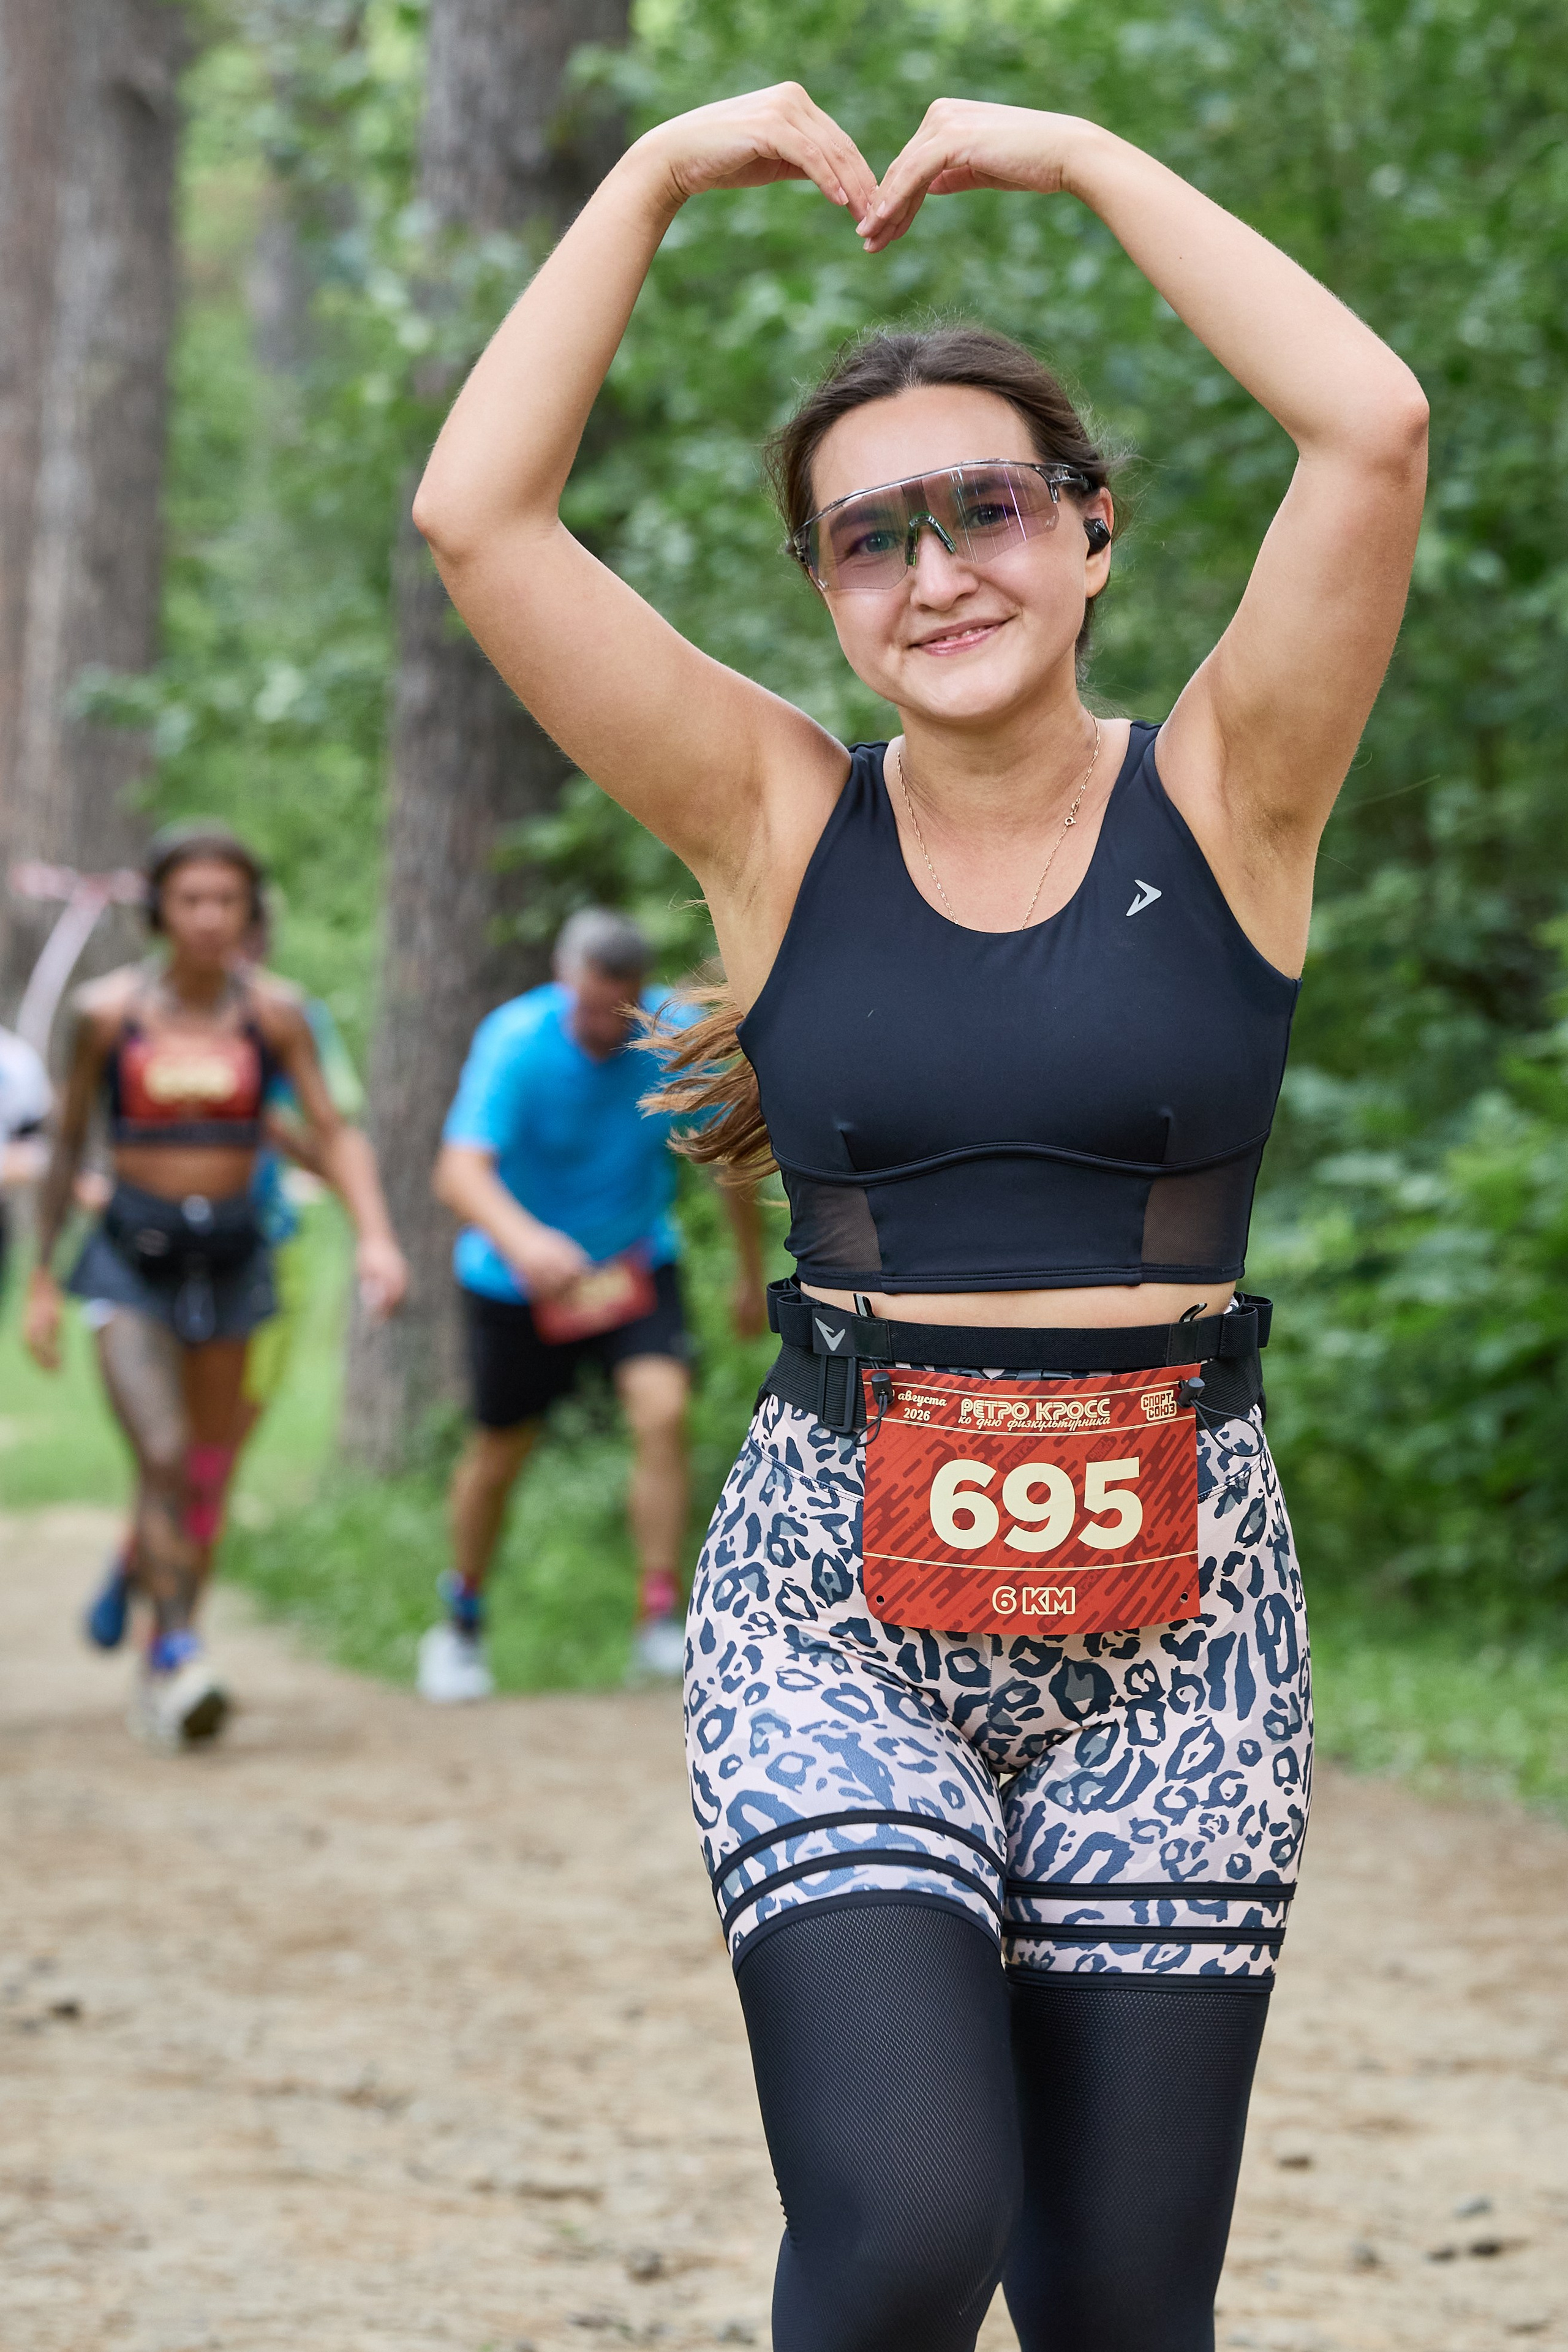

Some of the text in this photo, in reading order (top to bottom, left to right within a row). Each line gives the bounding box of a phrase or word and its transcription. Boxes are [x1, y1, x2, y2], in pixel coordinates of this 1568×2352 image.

[898, 1390, 947, 1407] августа
[1143, 1392, 1172, 1408] СПОРТ
[903, 1407, 930, 1421] 2026
[961, 1398, 1110, 1420] РЕТРО КРОСС
[1148, 1403, 1175, 1418] СОЮЗ
[958, 1416, 1110, 1431] ко дню физкультурника
[929, 1456, 1143, 1553] 695
[992, 1586, 1076, 1615] 6 КМ
